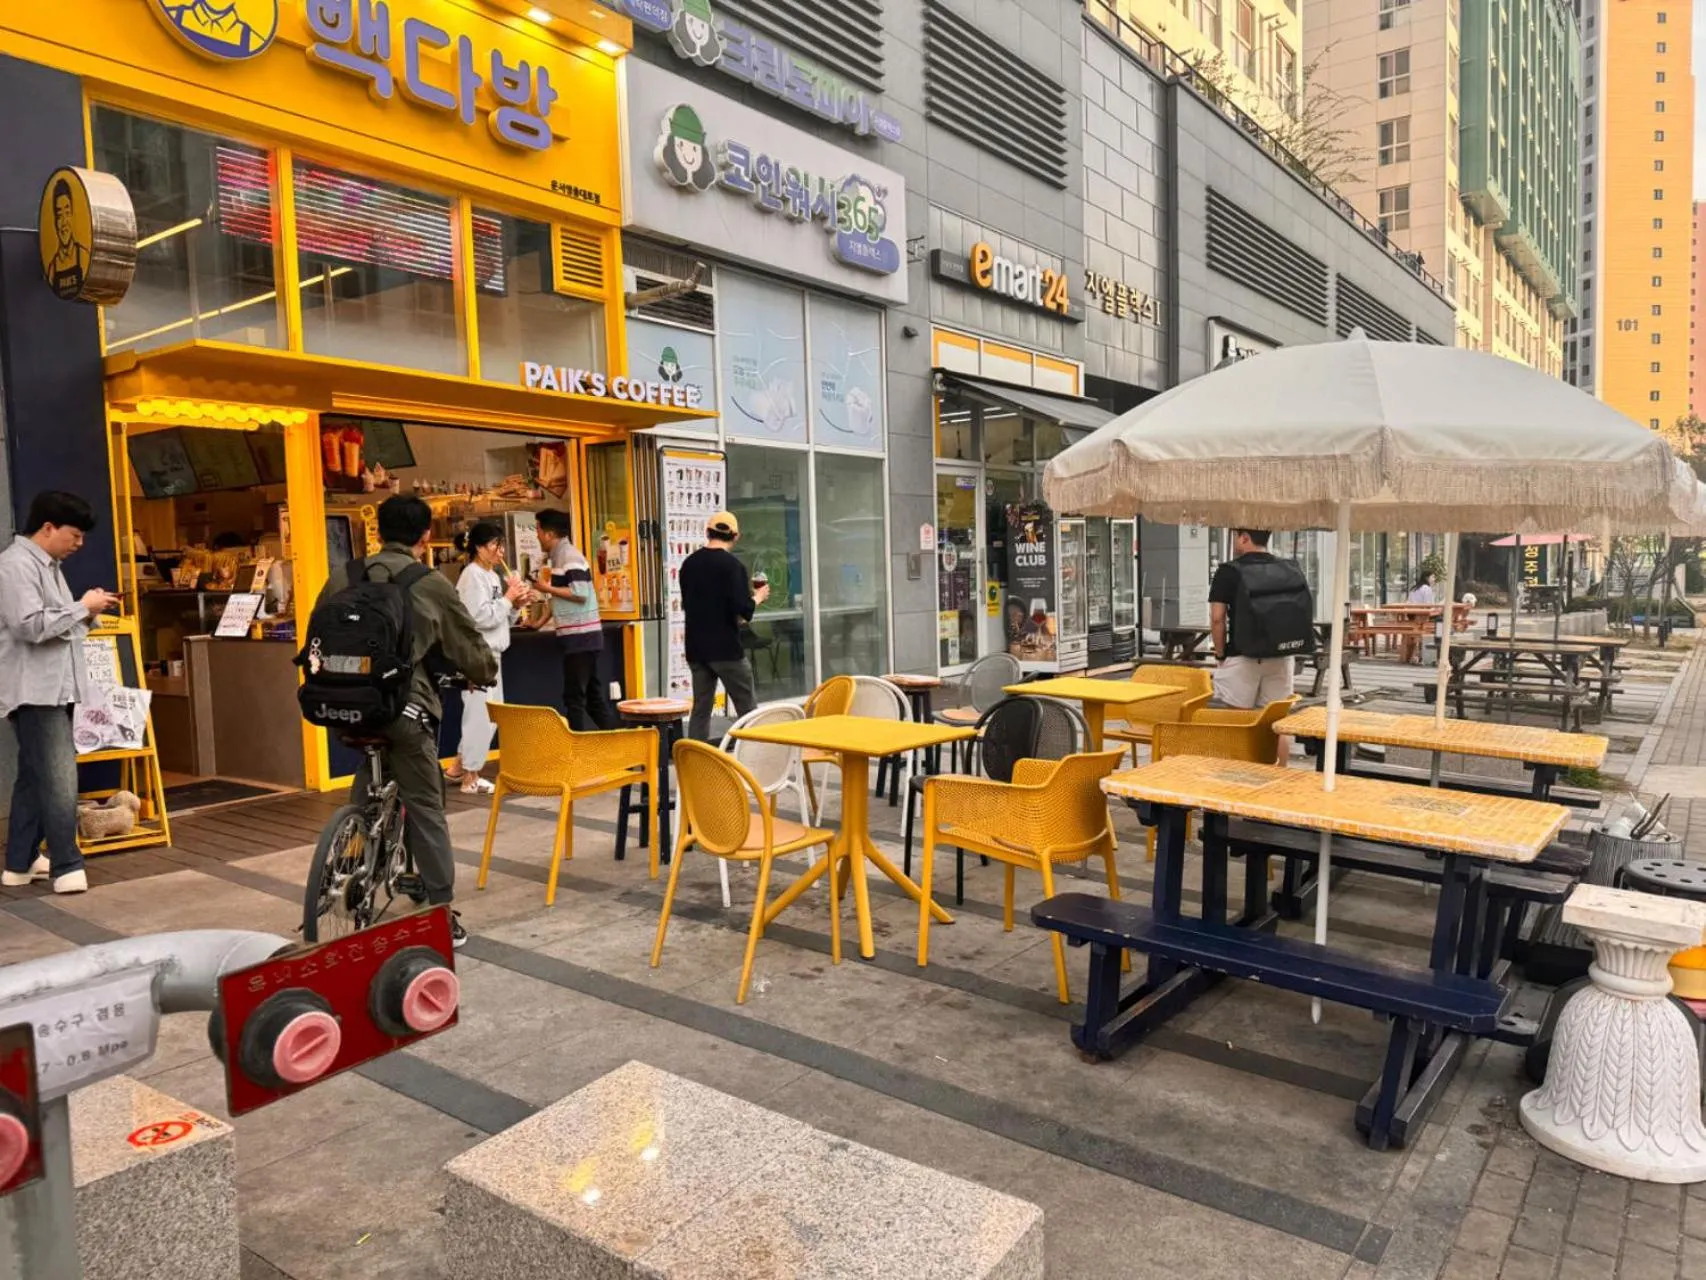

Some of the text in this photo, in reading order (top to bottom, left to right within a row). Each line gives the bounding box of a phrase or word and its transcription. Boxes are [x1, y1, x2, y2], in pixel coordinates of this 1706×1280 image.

[970, 240, 1070, 316] emart24
[1616, 318, 1639, 332] 101
[521, 361, 607, 398] PAIK'S
[611, 374, 701, 408] COFFEE
[1015, 541, 1046, 554] WINE
[1015, 554, 1047, 567] CLUB
[315, 703, 362, 724] Jeep
